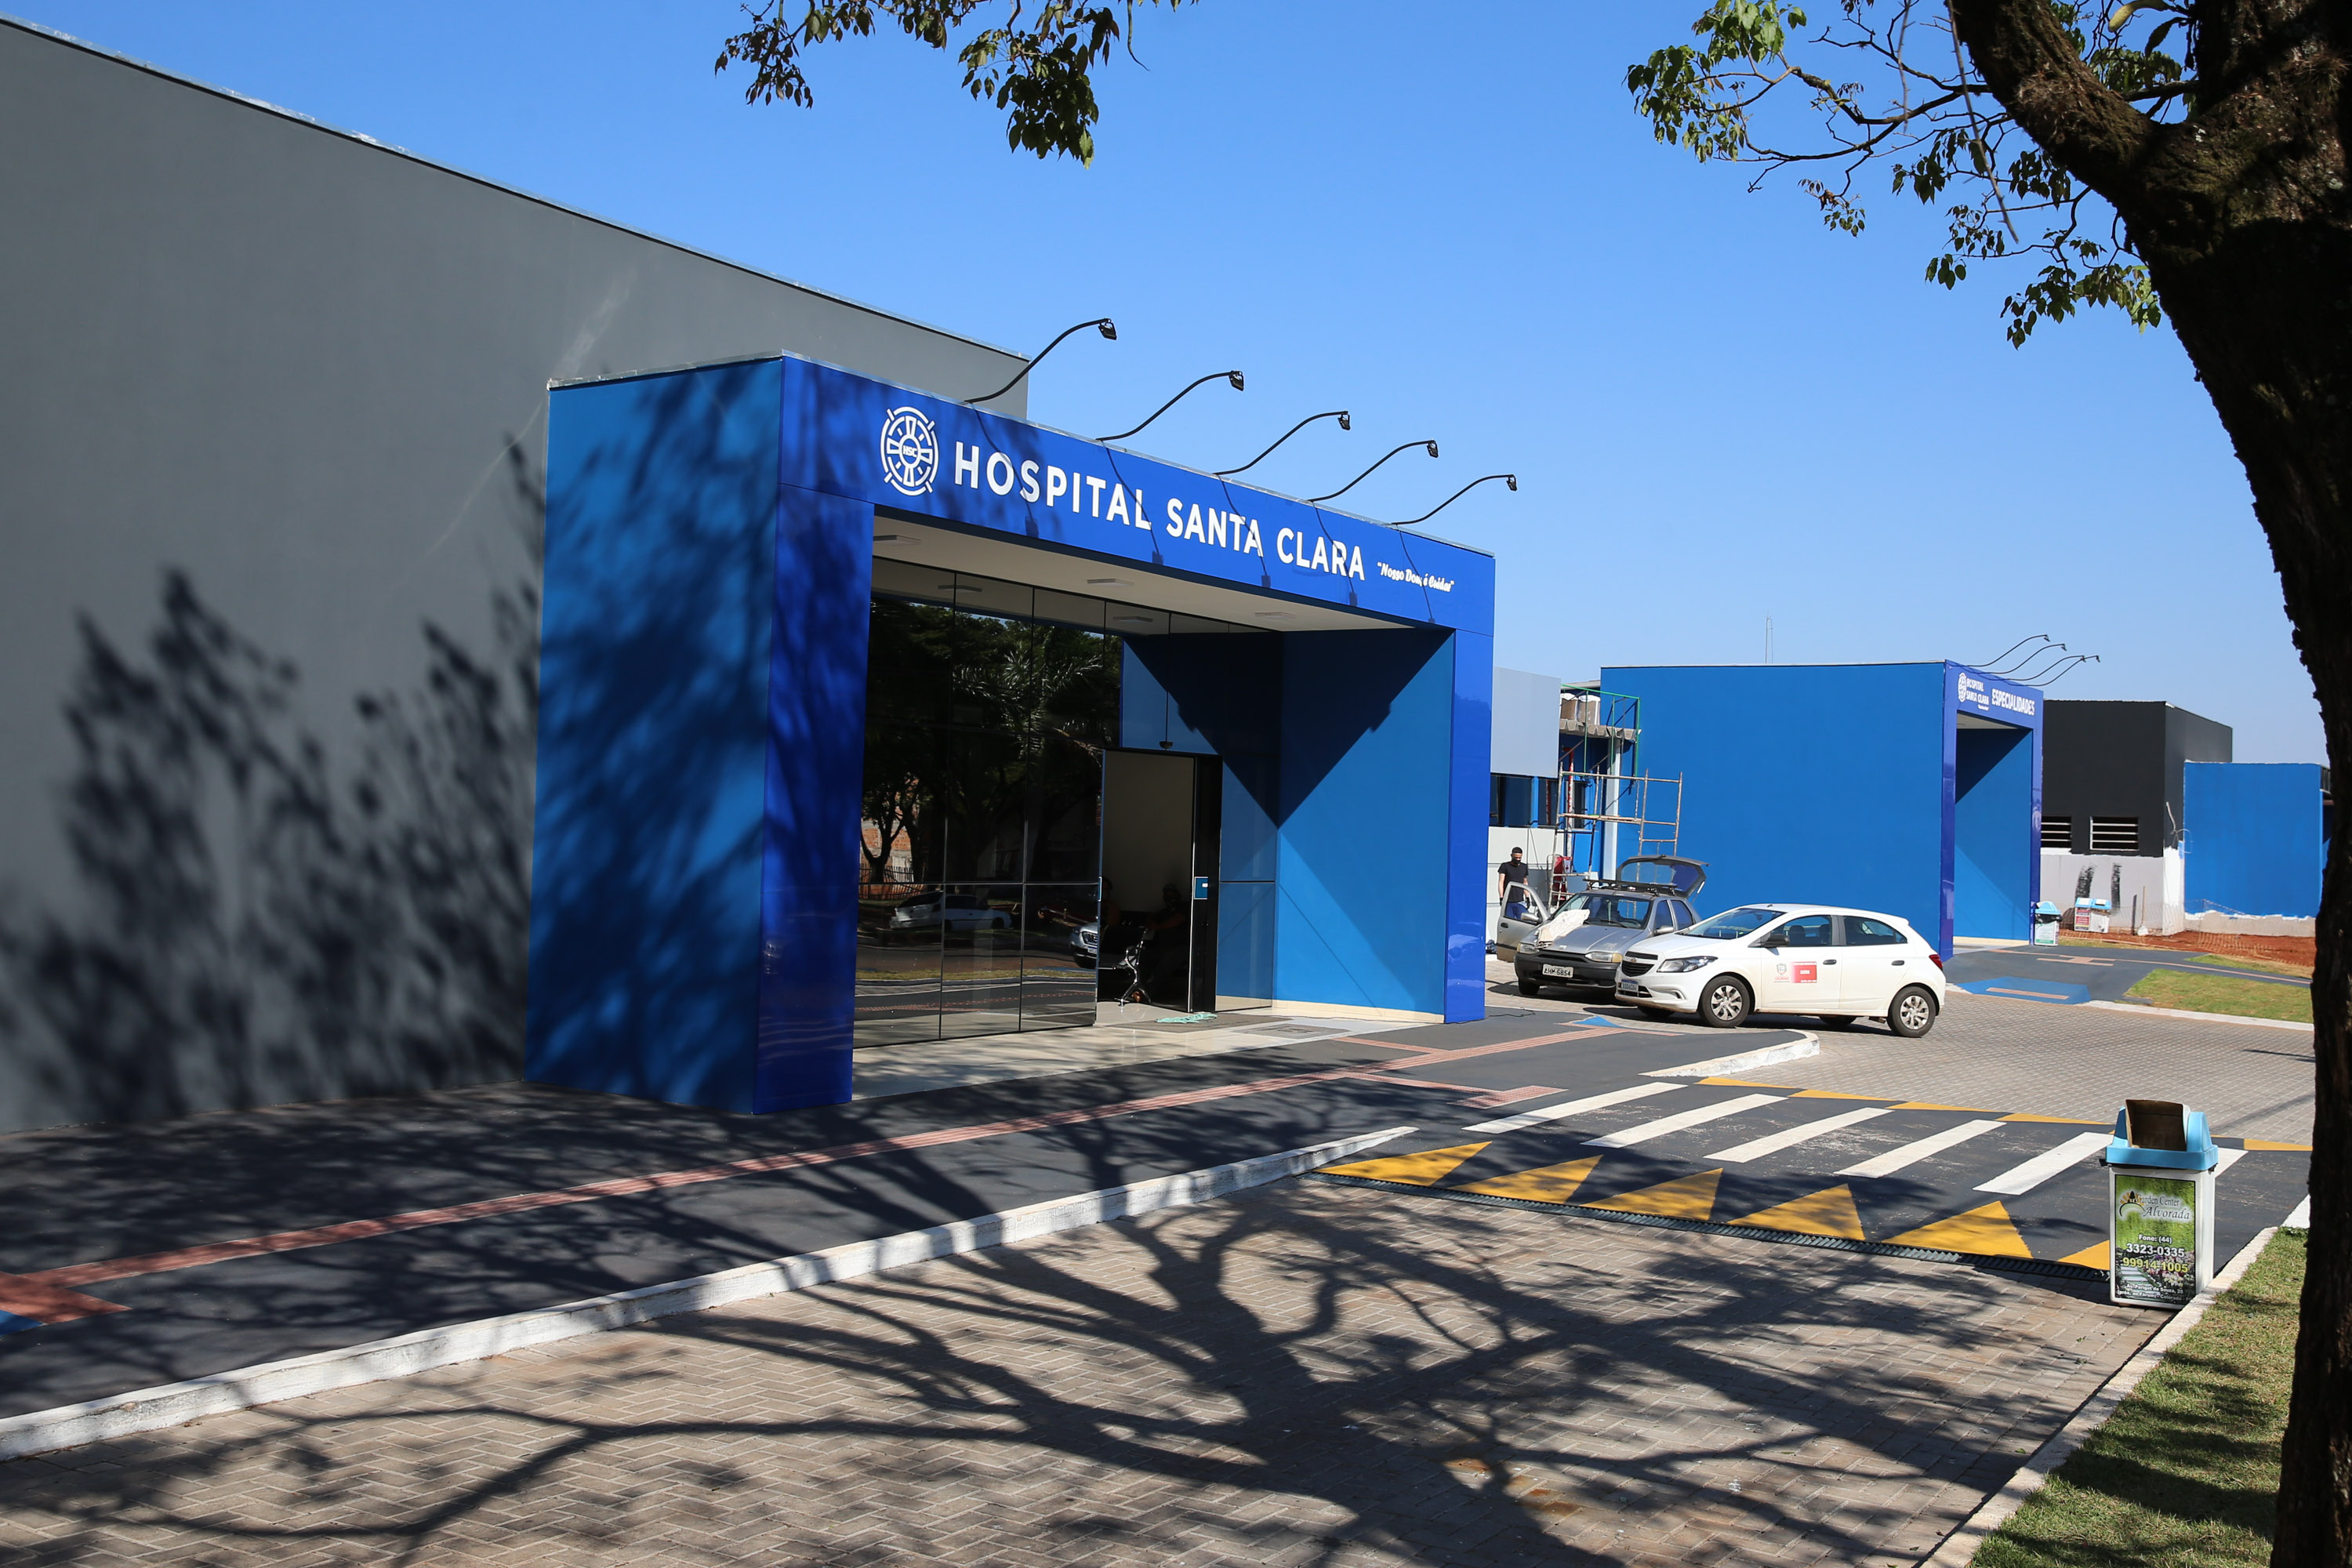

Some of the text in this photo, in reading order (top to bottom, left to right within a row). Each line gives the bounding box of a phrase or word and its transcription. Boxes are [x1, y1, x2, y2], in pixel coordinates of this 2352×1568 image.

[902, 445, 918, 458] HSC
[954, 441, 1366, 581] HOSPITAL SANTA CLARA
[1423, 573, 1429, 586] é
[1991, 688, 2035, 716] ESPECIALIDADES
[2136, 1194, 2180, 1207] Garden Center
[2143, 1206, 2190, 1219] Alvorada
[2158, 1236, 2172, 1244] (44)
[2126, 1243, 2185, 1258] 3323-0335
[2122, 1257, 2188, 1273] 99914-1005
